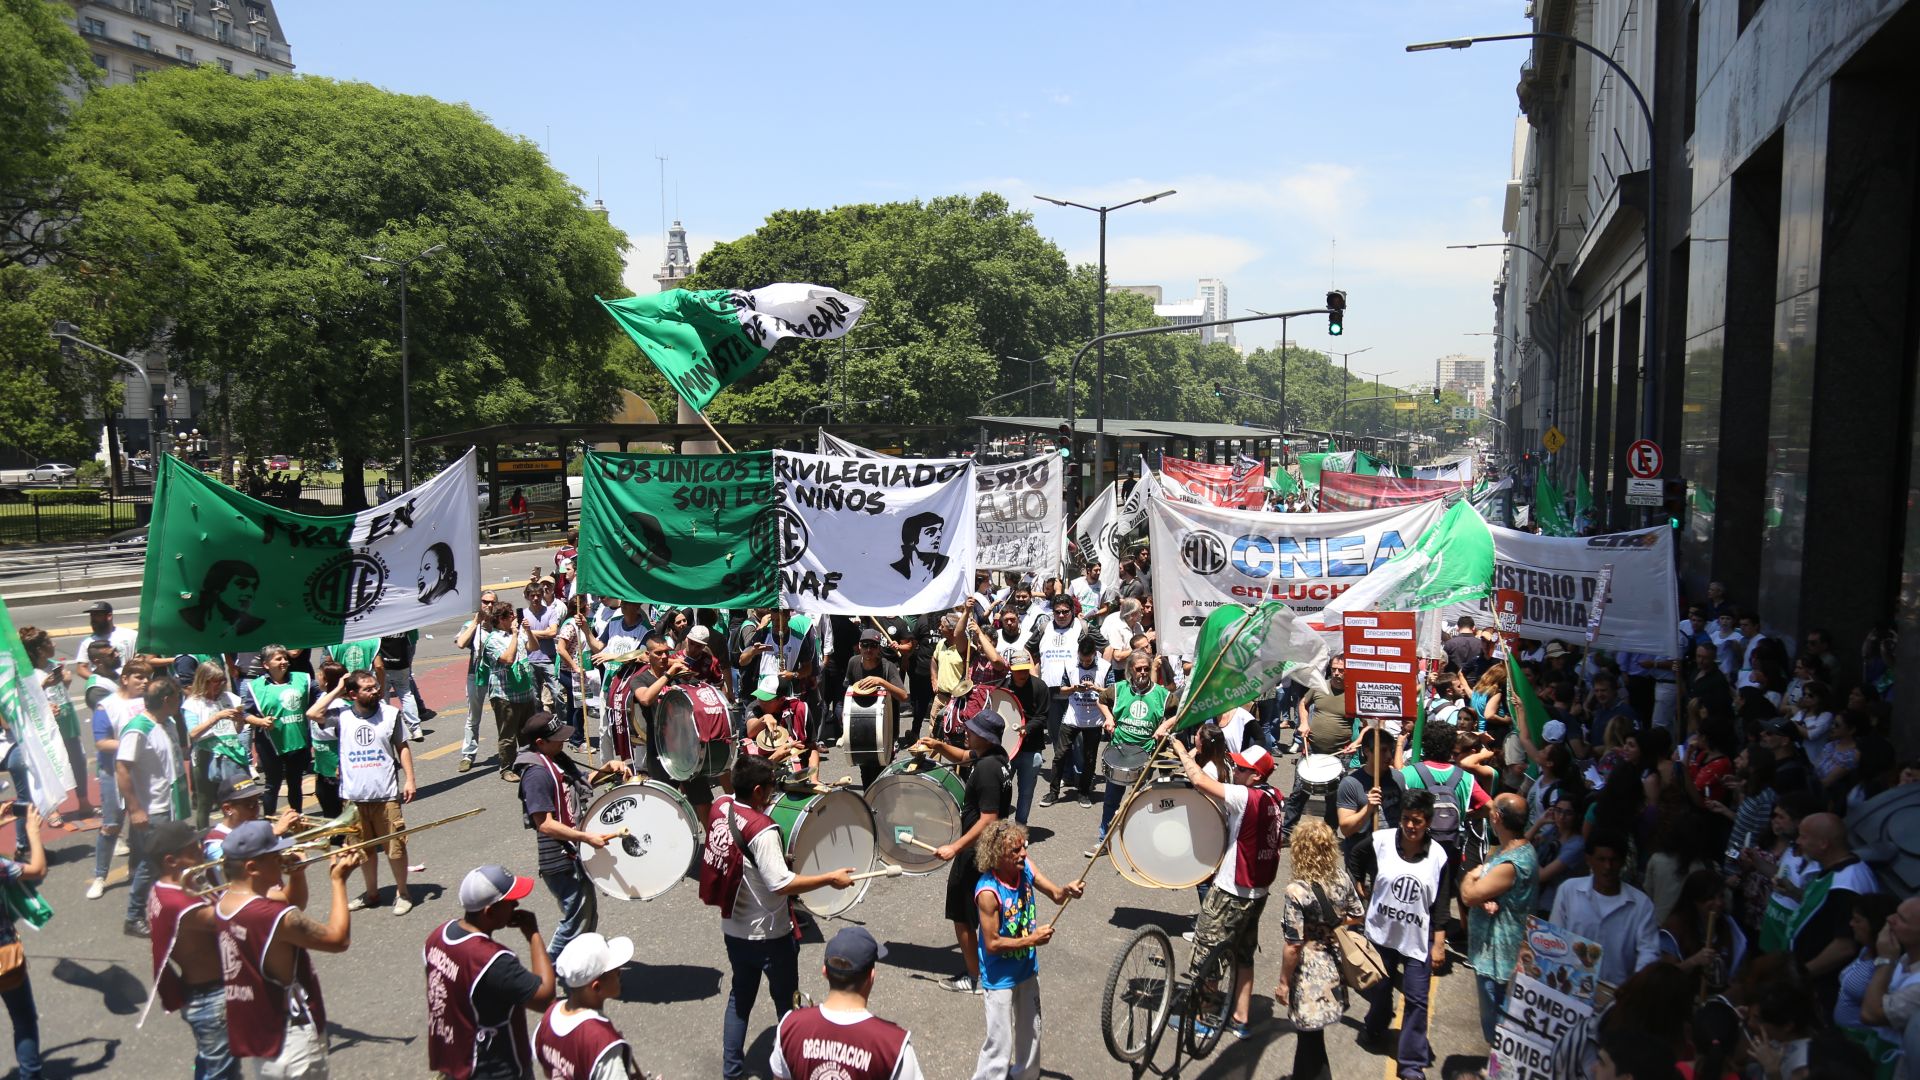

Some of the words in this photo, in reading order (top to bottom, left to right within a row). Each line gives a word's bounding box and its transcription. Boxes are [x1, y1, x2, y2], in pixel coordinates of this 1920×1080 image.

[601, 458, 652, 484] LOS
[655, 457, 749, 483] UNICOS
[1638, 447, 1652, 472] E
[673, 485, 727, 511] SON
[736, 481, 787, 506] LOS
[795, 483, 886, 515] NIÑOS
[998, 521, 1051, 534] SOCIAL
[1231, 530, 1407, 579] CNEA
[1231, 585, 1264, 599] en
[1224, 677, 1264, 702] Capital
[1360, 702, 1399, 711] IZQUIERDA
[356, 727, 373, 744] ATE
[348, 749, 386, 763] CNEA
[1393, 876, 1420, 902] ATE
[803, 1039, 872, 1072] ORGANIZACION
